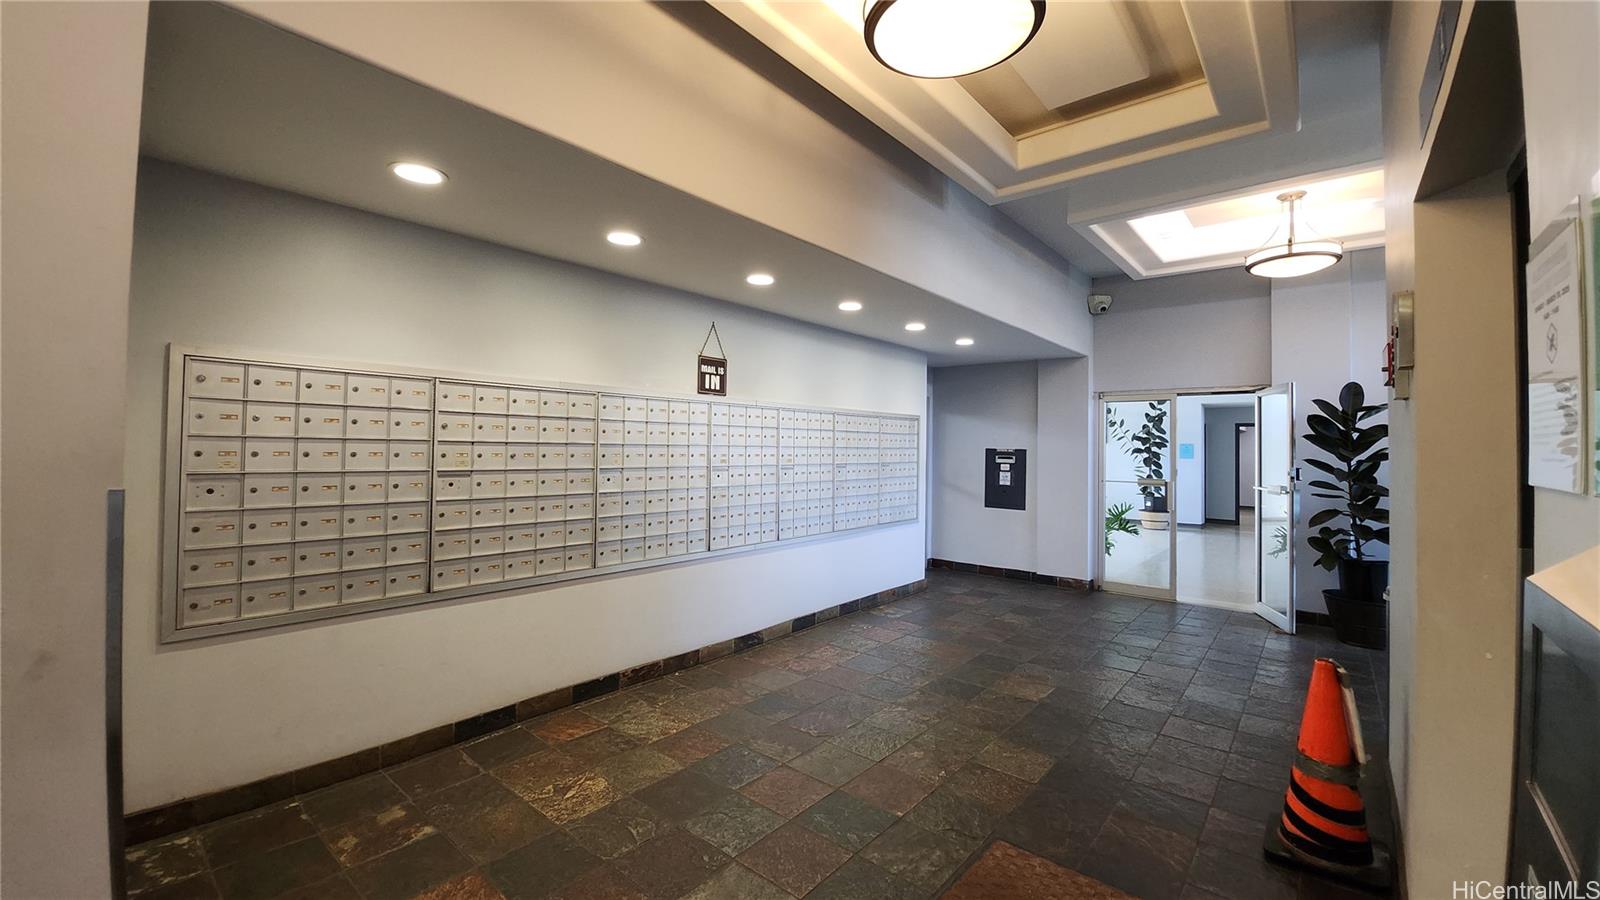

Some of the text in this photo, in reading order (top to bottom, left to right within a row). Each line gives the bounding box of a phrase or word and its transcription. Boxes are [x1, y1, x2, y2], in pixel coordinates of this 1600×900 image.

[701, 364, 725, 375] MAIL IS
[705, 374, 720, 391] IN
